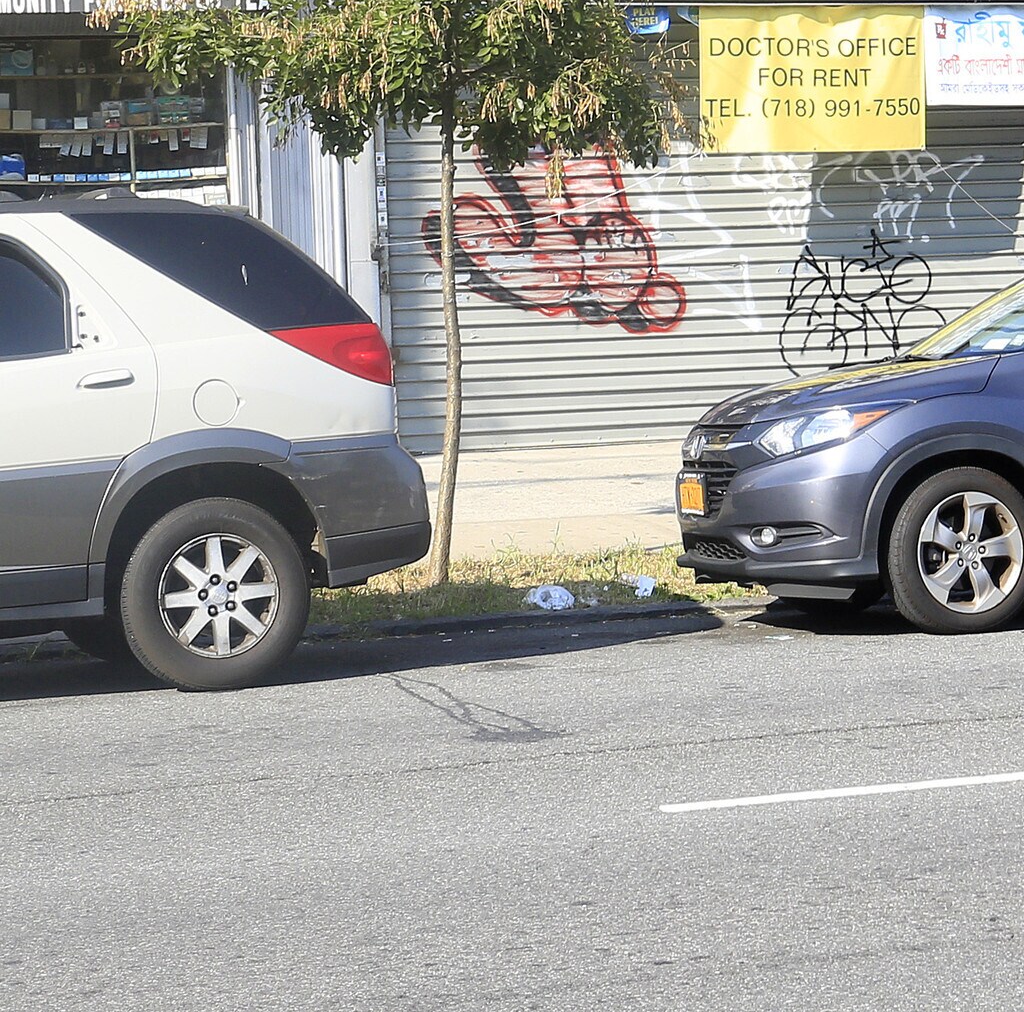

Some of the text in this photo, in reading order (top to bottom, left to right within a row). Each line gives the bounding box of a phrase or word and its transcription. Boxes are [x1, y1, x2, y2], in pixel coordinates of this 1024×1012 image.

[632, 7, 657, 17] PLAY
[709, 37, 917, 58] DOCTOR'S OFFICE
[758, 67, 872, 87] FOR RENT
[705, 97, 920, 119] TEL. (718) 991-7550
